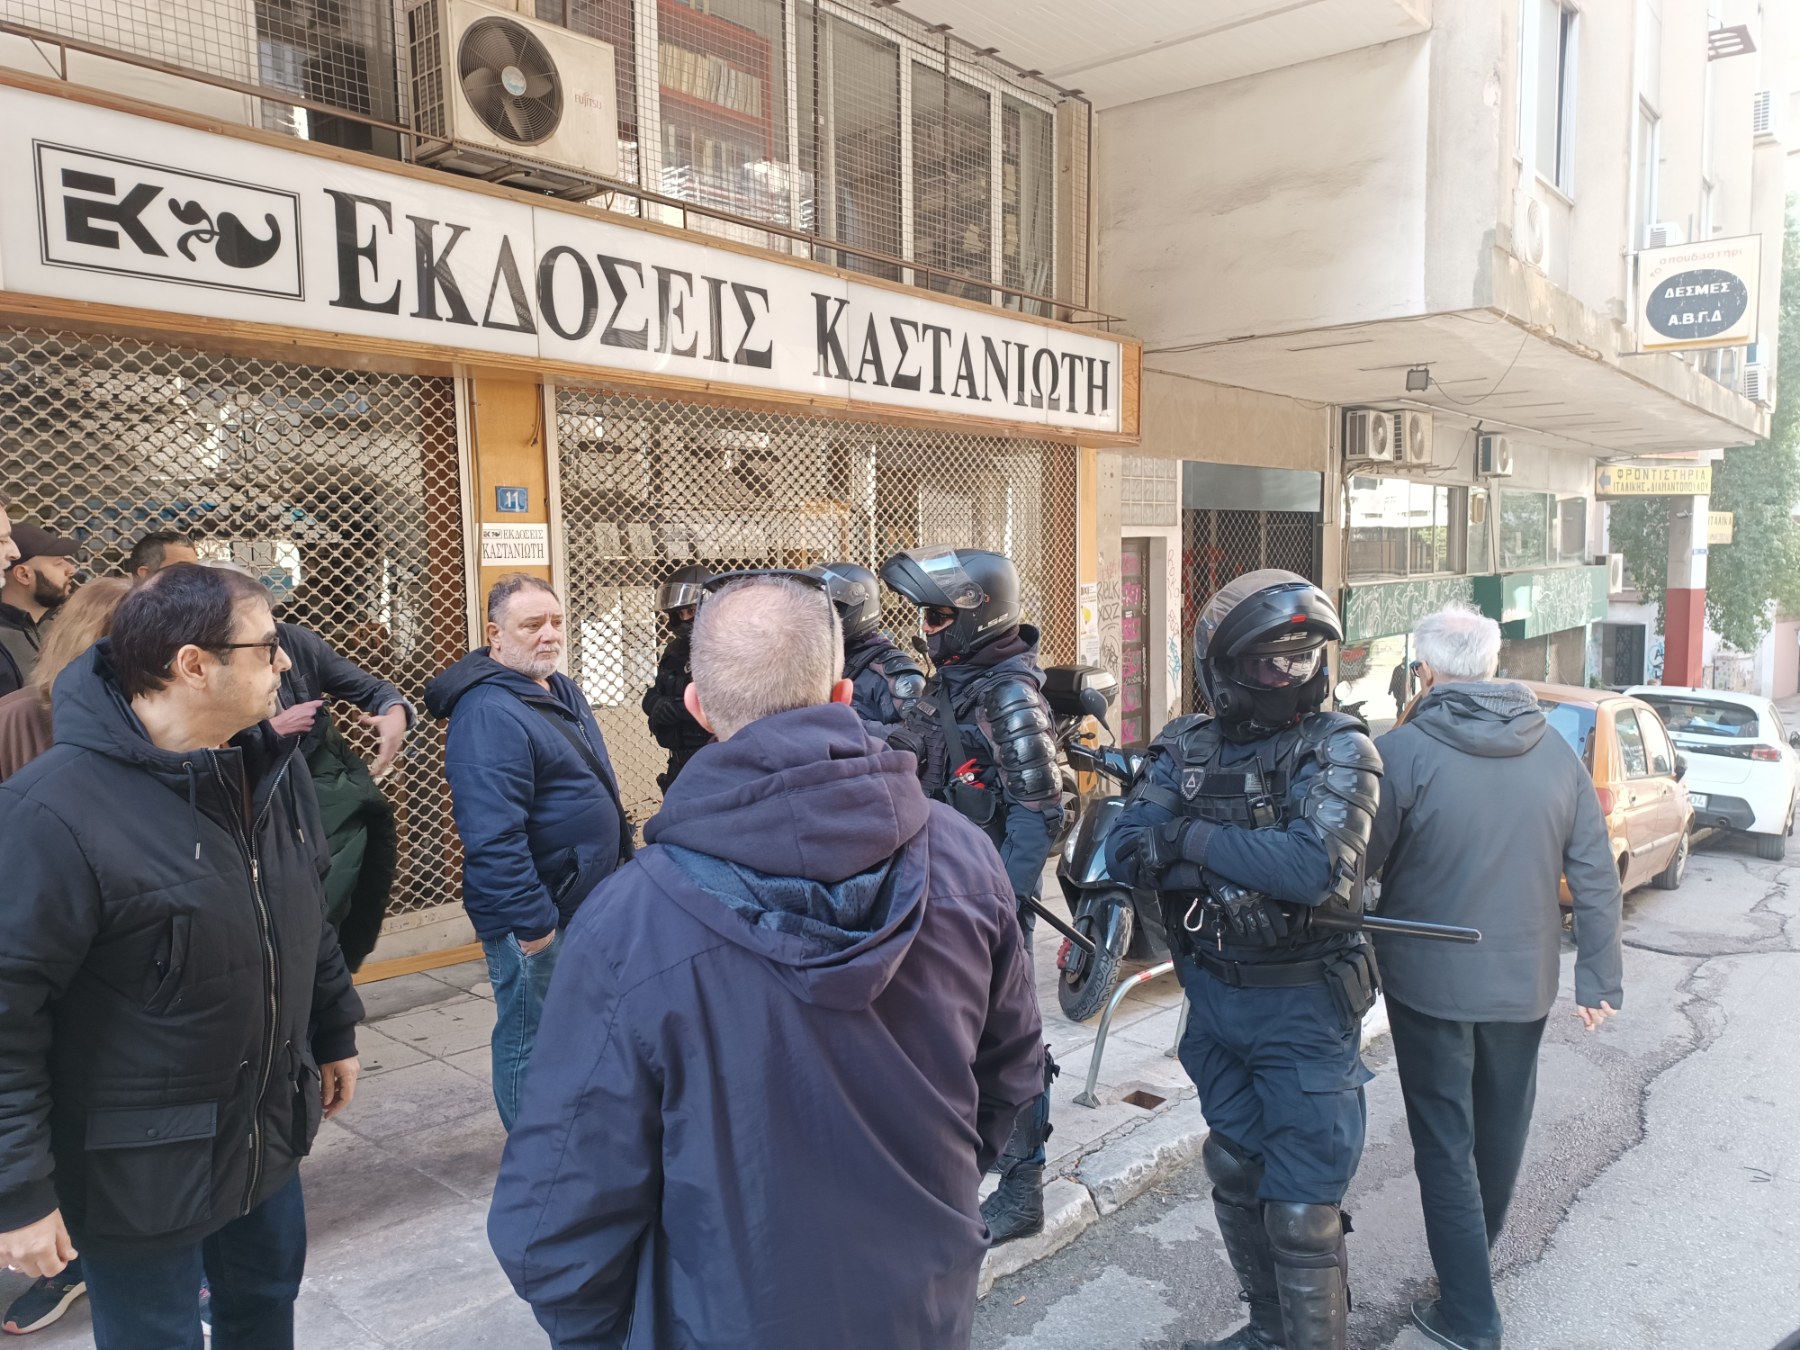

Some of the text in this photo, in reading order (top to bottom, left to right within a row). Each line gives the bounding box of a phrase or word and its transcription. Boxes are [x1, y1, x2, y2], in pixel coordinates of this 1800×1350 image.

[574, 93, 602, 110] FUJITSU
[1664, 281, 1731, 299] ΔΕΣΜΕΣ
[323, 187, 1110, 417] ΕΚΔΟΣΕΙΣ ΚΑΣΤΑΝΙΩΤΗ
[1667, 309, 1722, 326] Α.Β.Γ.Δ
[1617, 468, 1706, 481] ΦΡΟΝΤΙΣΤΗΡΙΑ
[506, 490, 520, 512] 11
[503, 529, 543, 540] ΕΚΔΟΣΕΙΣ
[482, 543, 544, 559] ΚΑΣΤΑΝΙΩΤΗ
[977, 612, 1009, 633] LS2
